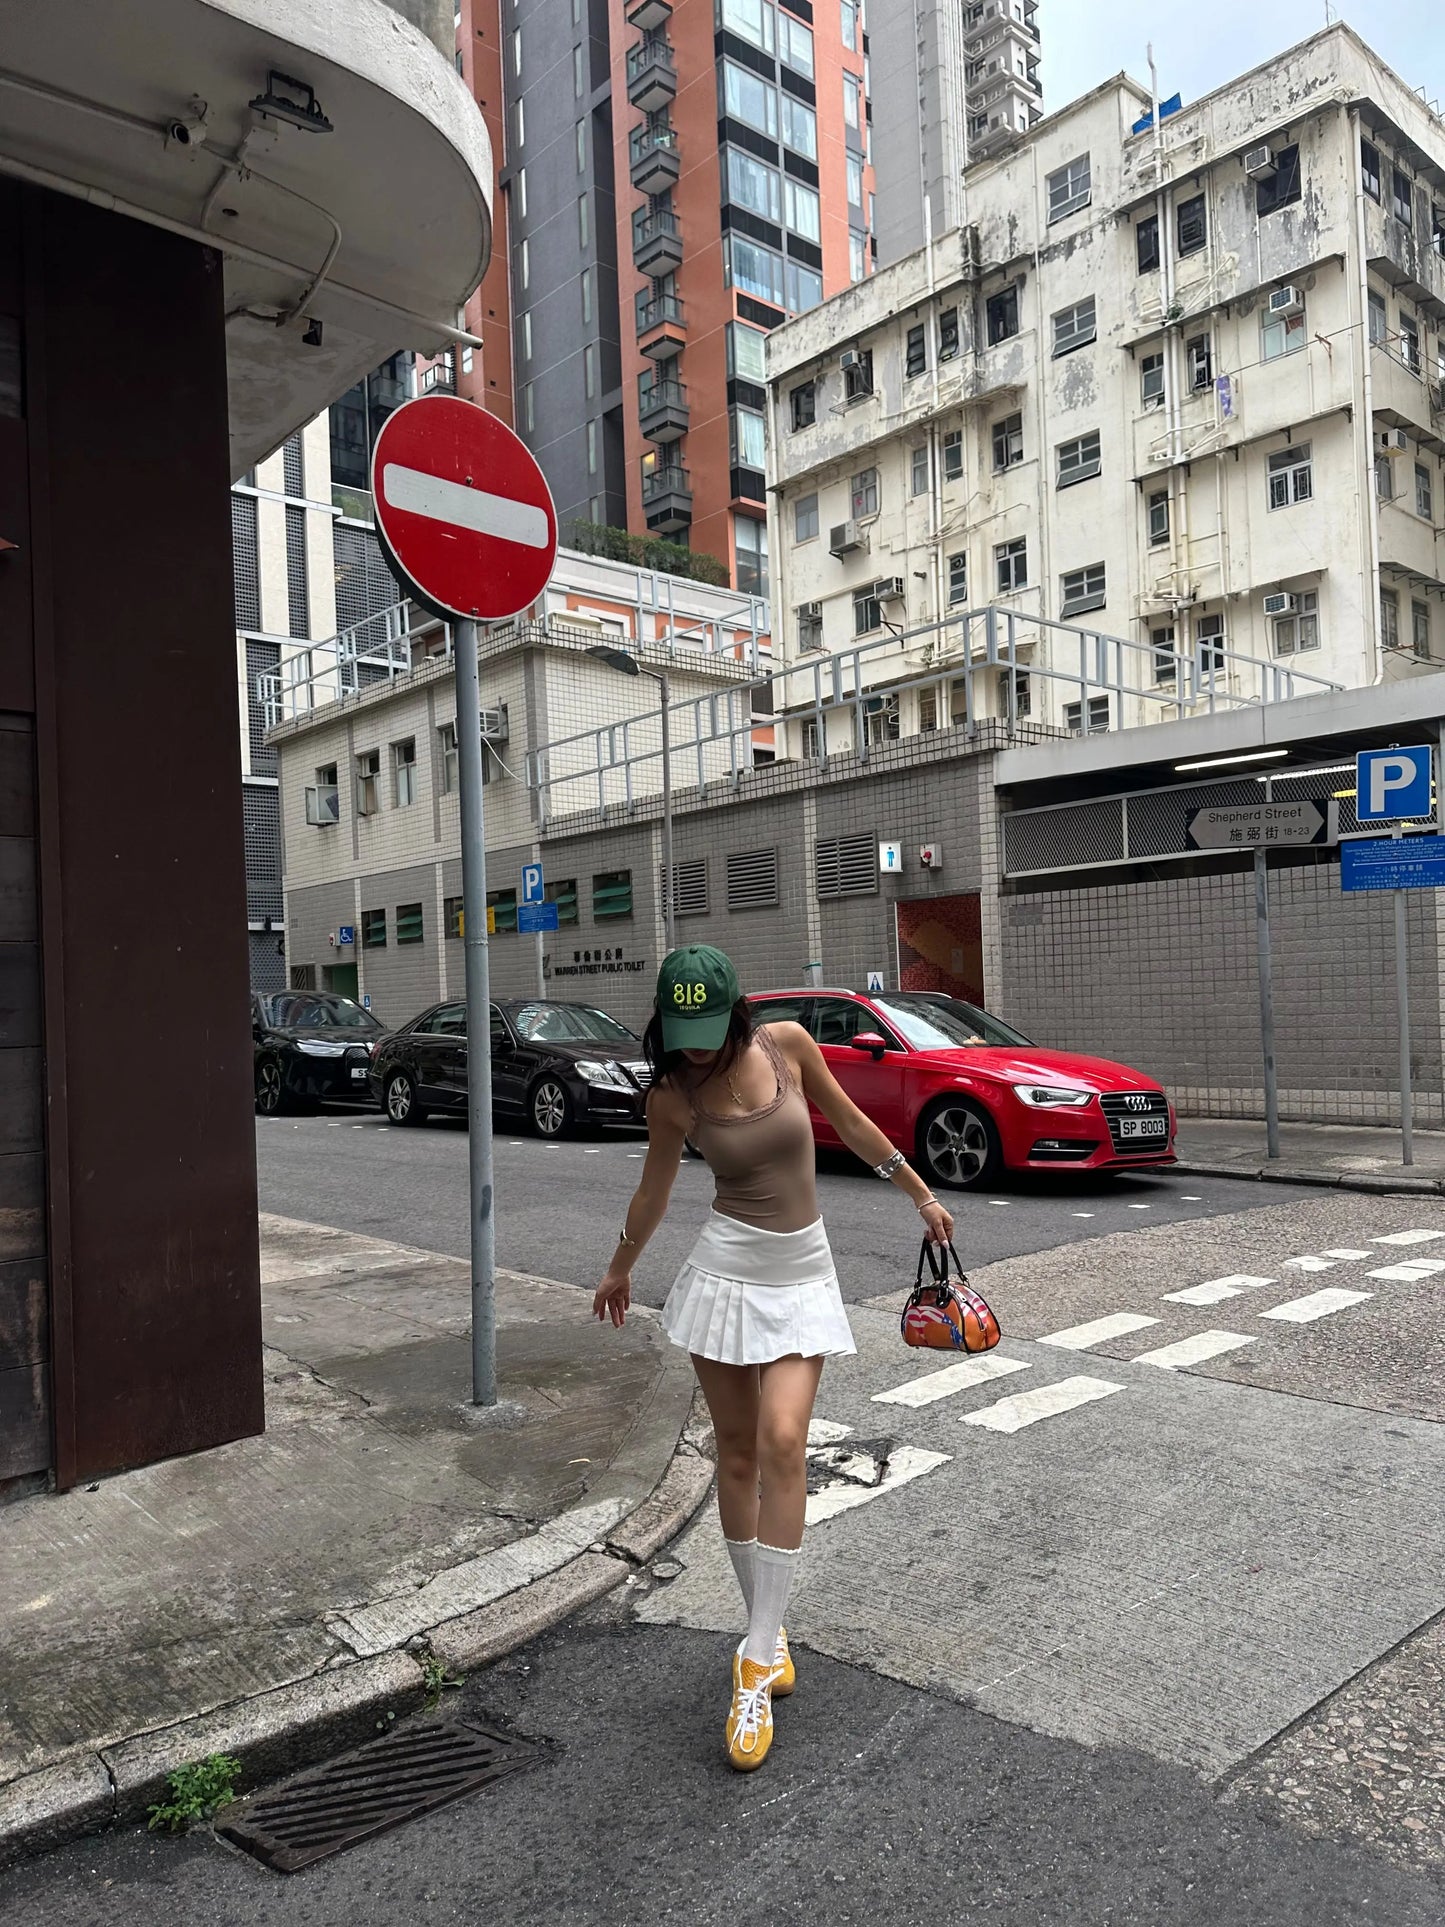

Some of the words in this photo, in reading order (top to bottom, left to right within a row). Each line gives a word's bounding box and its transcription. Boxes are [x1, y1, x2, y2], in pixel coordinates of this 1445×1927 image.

[1370, 756, 1417, 813] P
[1208, 810, 1261, 823] Shepherd
[1265, 806, 1302, 819] Street
[1229, 826, 1279, 841] 施弼街
[1283, 827, 1310, 836] 18-23
[525, 868, 540, 900] P
[554, 966, 579, 976] WARREN
[579, 964, 601, 975] STREET
[602, 962, 623, 973] PUBLIC
[623, 961, 645, 971] TOILET
[673, 983, 707, 1005] 818
[1123, 1121, 1137, 1135] SP
[1141, 1120, 1164, 1134] 8003
